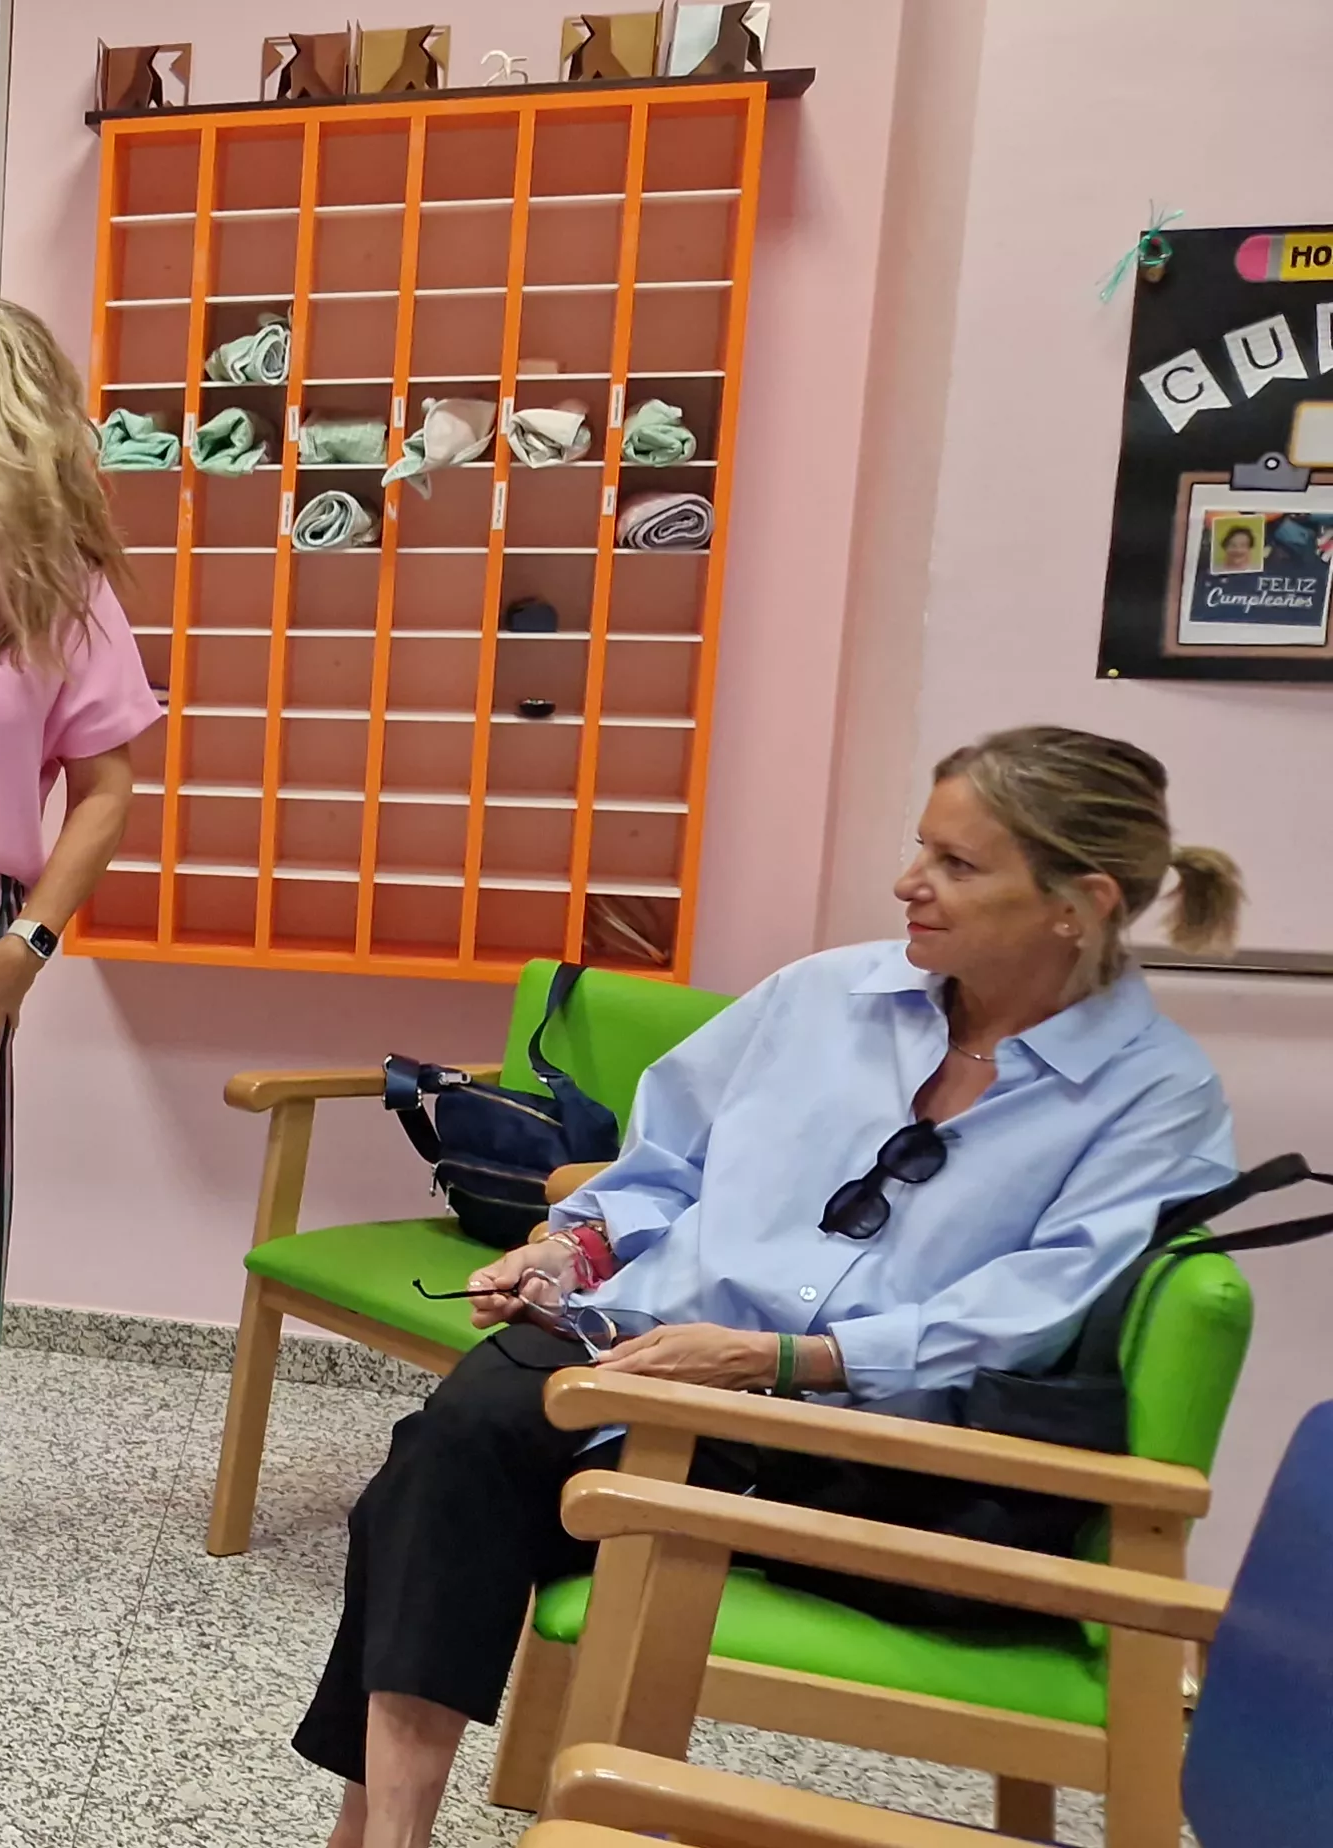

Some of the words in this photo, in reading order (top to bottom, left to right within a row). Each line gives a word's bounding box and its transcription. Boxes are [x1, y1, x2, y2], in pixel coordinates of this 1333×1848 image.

[1162, 312, 1333, 404] CU
[1257, 577, 1317, 593] FELIZ
[1206, 586, 1313, 613] Cumpleaños
